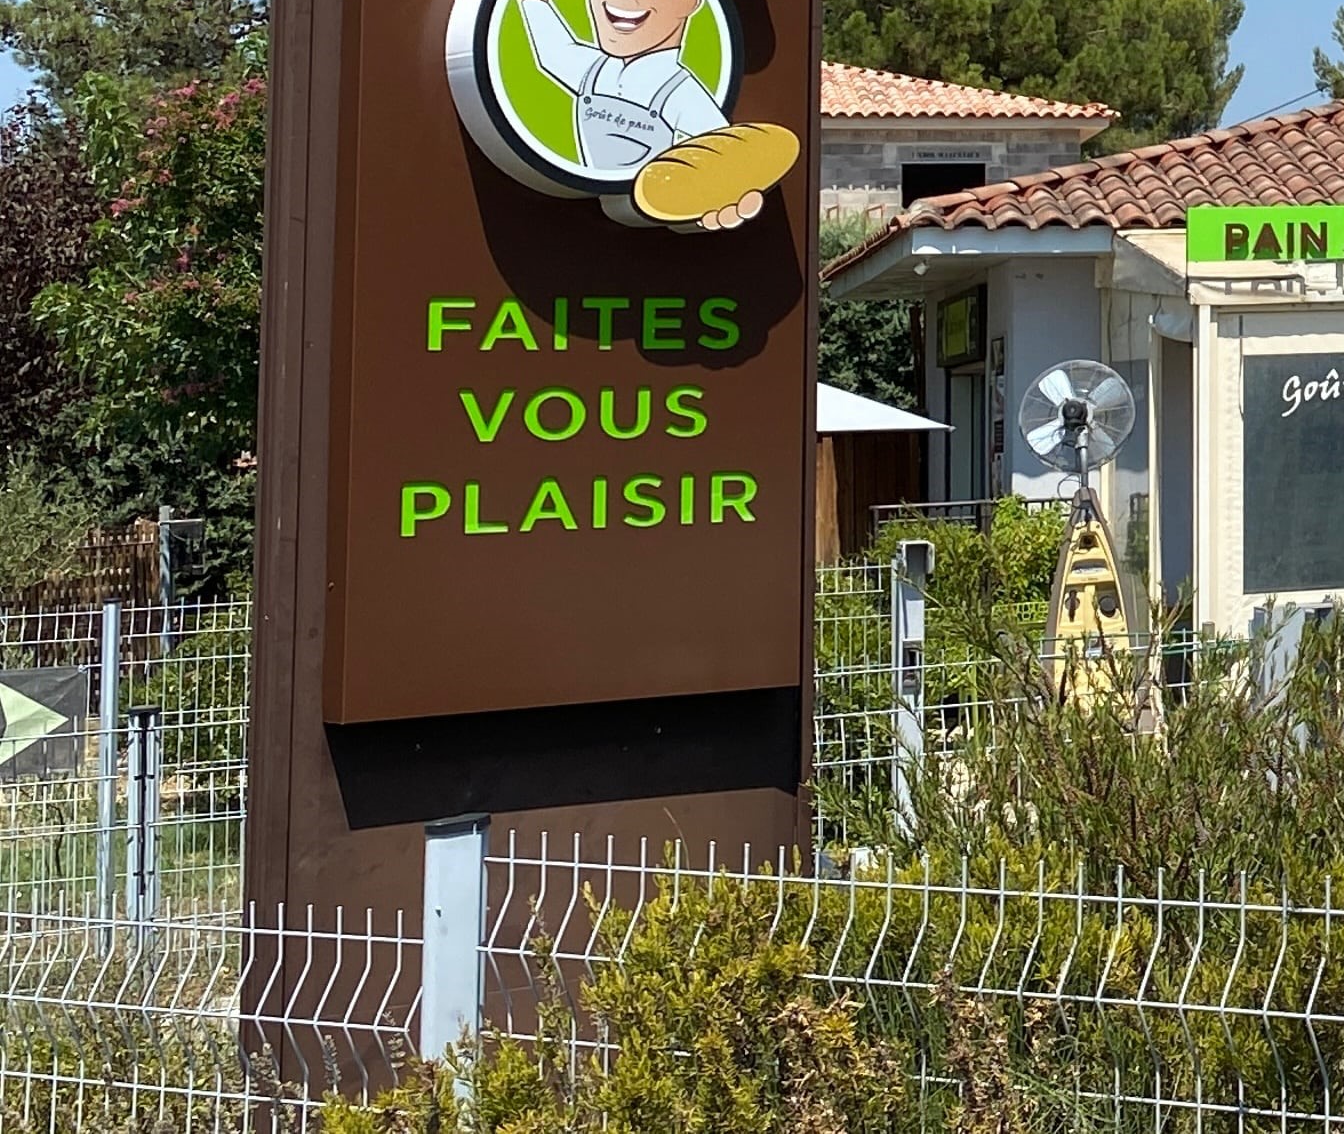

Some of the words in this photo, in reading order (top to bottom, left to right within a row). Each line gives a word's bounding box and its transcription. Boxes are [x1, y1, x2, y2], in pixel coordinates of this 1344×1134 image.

[583, 107, 613, 122] Goût
[614, 114, 626, 127] de
[625, 120, 655, 132] pain
[1225, 221, 1328, 253] PAIN
[425, 297, 741, 352] FAITES
[458, 385, 709, 444] VOUS
[399, 470, 760, 538] PLAISIR
